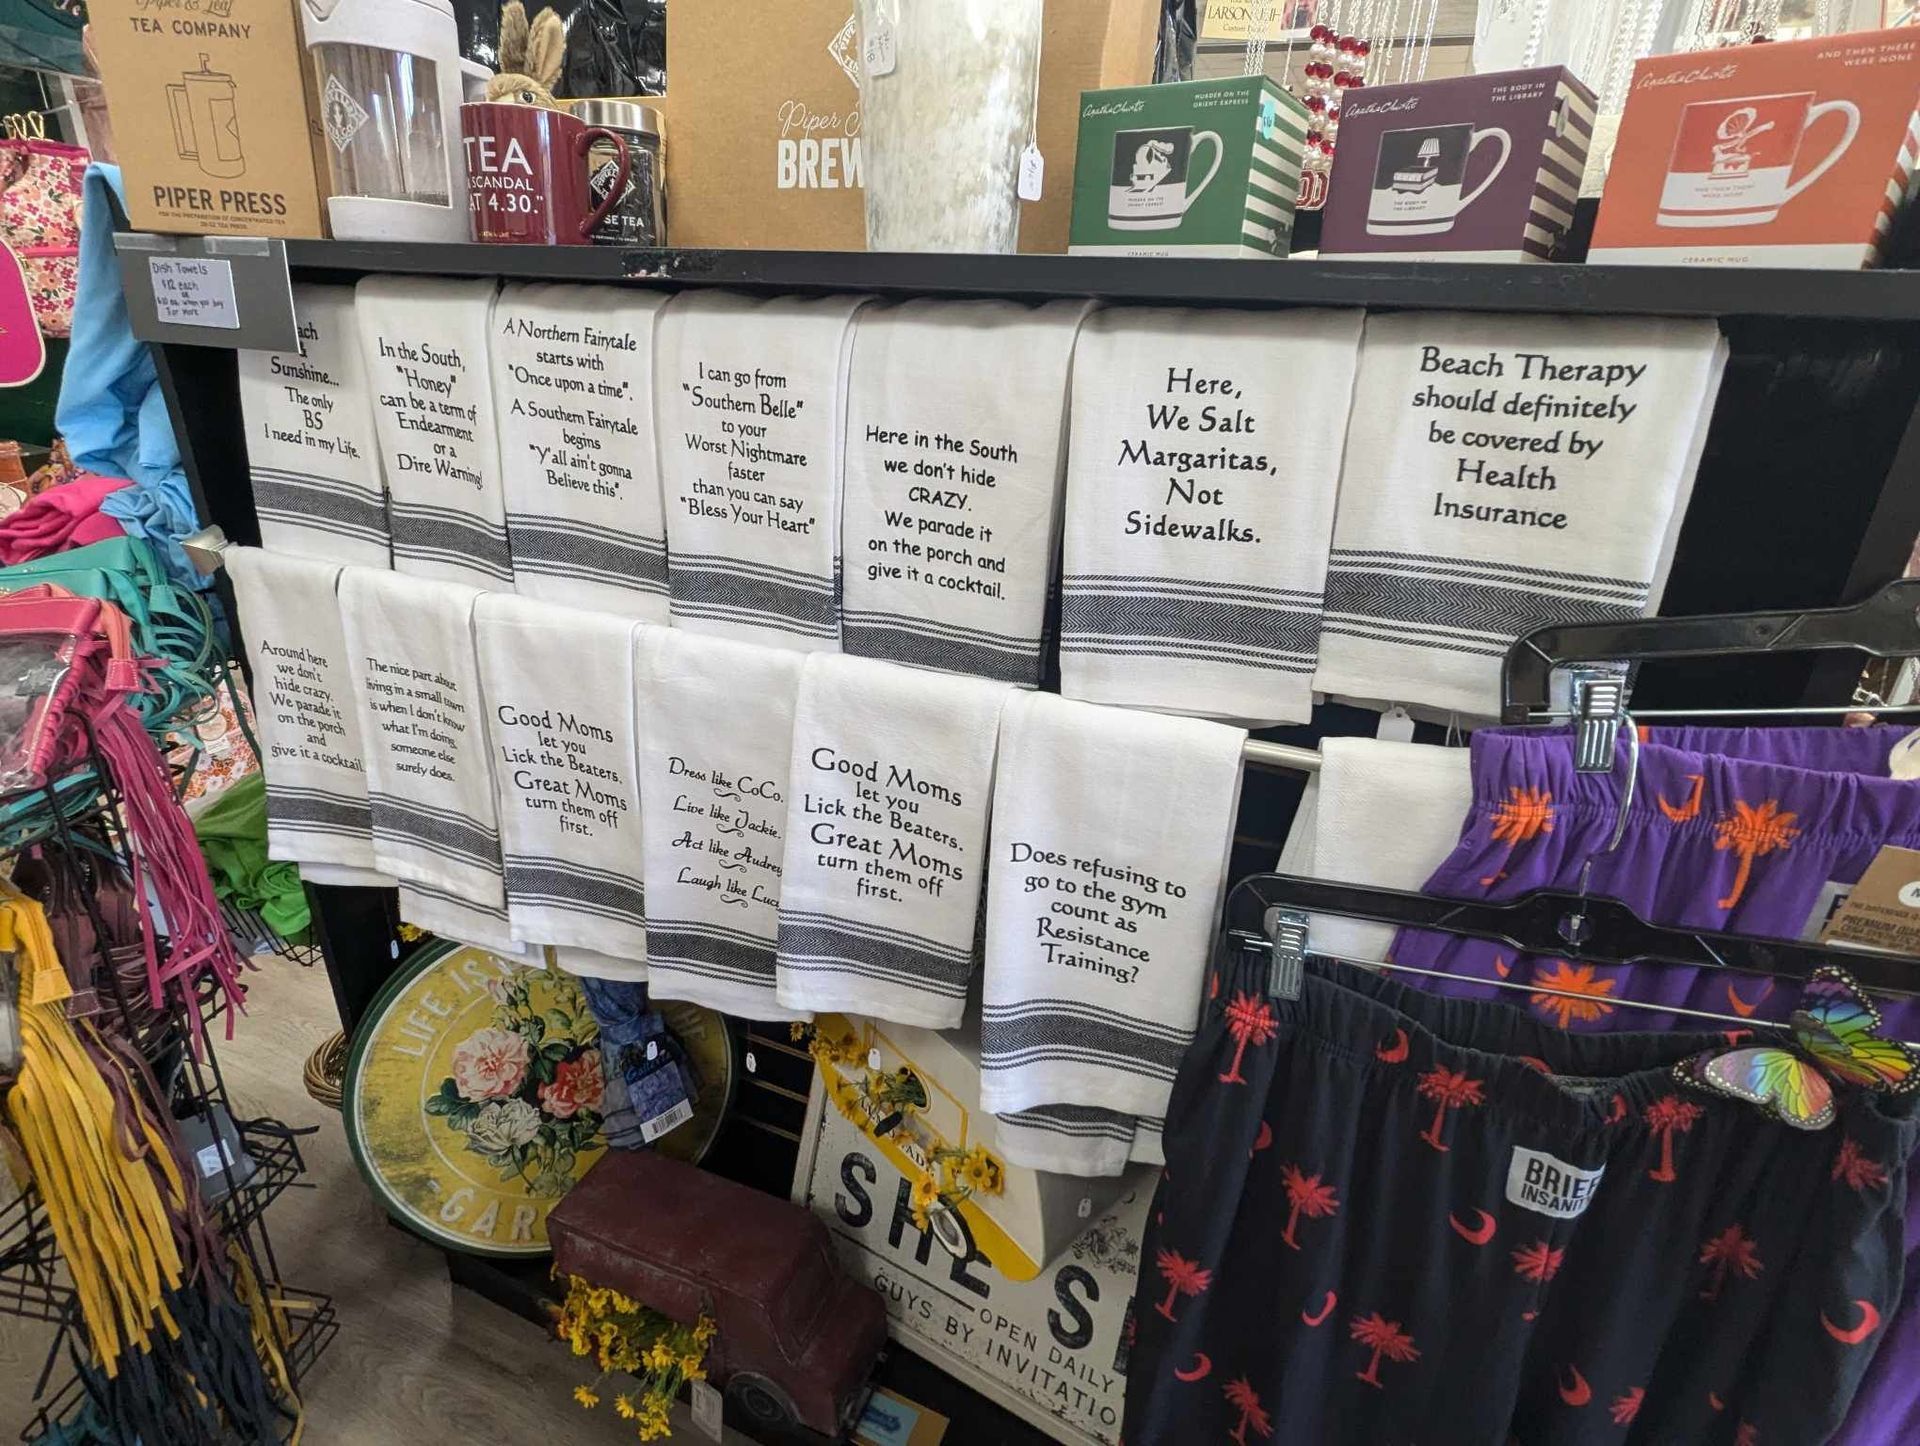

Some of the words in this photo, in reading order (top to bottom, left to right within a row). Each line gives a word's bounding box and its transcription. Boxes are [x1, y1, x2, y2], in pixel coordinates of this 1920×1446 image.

[129, 17, 164, 33] TEA
[172, 20, 251, 39] COMPANY
[1817, 50, 1841, 60] AND
[1846, 46, 1875, 56] THEN
[1880, 42, 1916, 52] THERE
[1844, 57, 1874, 67] WERE
[1880, 53, 1912, 63] NONE
[1194, 92, 1222, 100] MURDER
[1220, 99, 1249, 107] EXPRESS
[1509, 91, 1543, 101] LIBRARY
[1510, 84, 1533, 93] BODY
[777, 100, 842, 138] Piper
[463, 136, 533, 175] TEA
[472, 176, 534, 191] SCANDAL
[153, 185, 213, 211] PIPER
[219, 189, 287, 216] PRESS
[488, 193, 544, 214] 4.30."
[621, 215, 645, 227] TEA
[152, 262, 172, 273] Dish
[176, 263, 208, 275] Towels
[179, 281, 199, 291] each
[503, 317, 515, 334] A
[518, 320, 579, 343] Northern
[584, 328, 637, 351] Fairytale
[270, 356, 339, 386] Sunshine...
[379, 338, 395, 357] In
[400, 342, 418, 361] the
[422, 344, 465, 372] South,
[1420, 346, 1504, 377] Beach
[1515, 353, 1646, 387] Therapy
[1167, 368, 1241, 399] Here,
[683, 383, 755, 413] "Southern
[760, 394, 803, 418] Belle"
[1412, 385, 1498, 413] should
[1503, 392, 1637, 423] definitely
[304, 410, 323, 429] BS
[1147, 404, 1190, 430] We
[1199, 406, 1255, 433] Salt
[265, 424, 269, 438] I
[272, 430, 301, 444] need
[305, 432, 316, 447] in
[319, 438, 334, 453] my
[337, 437, 361, 459] Life.
[685, 433, 728, 454] Worst
[731, 439, 807, 466] Nightmare
[866, 425, 908, 444] Here
[915, 431, 928, 448] in
[935, 434, 964, 452] the
[969, 440, 1017, 463] South
[1429, 421, 1455, 444] be
[1462, 431, 1563, 453] covered
[1568, 431, 1603, 460] by
[397, 454, 432, 473] Dire
[434, 459, 483, 491] Warning!
[884, 460, 908, 473] we
[914, 460, 955, 480] don't
[961, 466, 996, 487] hide
[1118, 440, 1276, 476] Margaritas,
[1456, 459, 1556, 490] Health
[909, 487, 971, 511] CRAZY.
[1166, 478, 1223, 505] Not
[1125, 511, 1260, 543] Sidewalks.
[1434, 493, 1567, 529] Insurance
[261, 640, 305, 661] Around
[306, 650, 327, 667] here
[274, 676, 300, 692] hide
[303, 686, 333, 703] crazy.
[370, 698, 377, 710] is
[379, 701, 407, 714] when
[410, 704, 413, 716] I
[417, 706, 441, 722] don't
[443, 714, 465, 732] know
[498, 706, 552, 728] Good
[557, 712, 613, 742] Moms
[396, 761, 426, 778] surely
[430, 765, 455, 781] does.
[502, 746, 536, 764] Lick
[541, 751, 564, 767] the
[568, 754, 622, 784] Beaters.
[668, 757, 706, 781] Dress
[712, 770, 732, 788] like
[737, 776, 783, 802] CoCo.
[673, 795, 704, 815] Live
[710, 804, 730, 822] like
[735, 809, 781, 839] Jackie.
[672, 831, 703, 850] Act
[709, 839, 729, 857] like
[811, 823, 882, 855] Great
[889, 839, 963, 880] Moms
[677, 867, 721, 890] Laugh
[726, 878, 747, 896] like
[818, 854, 858, 871] turn
[865, 859, 911, 884] them
[918, 877, 944, 897] off
[1010, 843, 1066, 866] Does
[1073, 859, 1159, 893] refusing
[1165, 881, 1186, 898] to
[857, 878, 902, 902] first.
[1024, 876, 1049, 892] go
[1056, 877, 1076, 893] to
[1083, 882, 1116, 902] the
[1121, 895, 1167, 919] gym
[1051, 902, 1109, 924] count
[1115, 917, 1137, 932] as
[1036, 917, 1150, 962] Resistance
[1041, 943, 1139, 983] Training?
[393, 991, 451, 1058] LIFE
[452, 957, 491, 997] IS
[874, 1275, 933, 1318] GUYS
[945, 1316, 974, 1343] BY
[986, 1339, 1116, 1427] INVITATIO
[980, 1308, 1037, 1351] OPEN
[1049, 1347, 1115, 1393] DAILY
